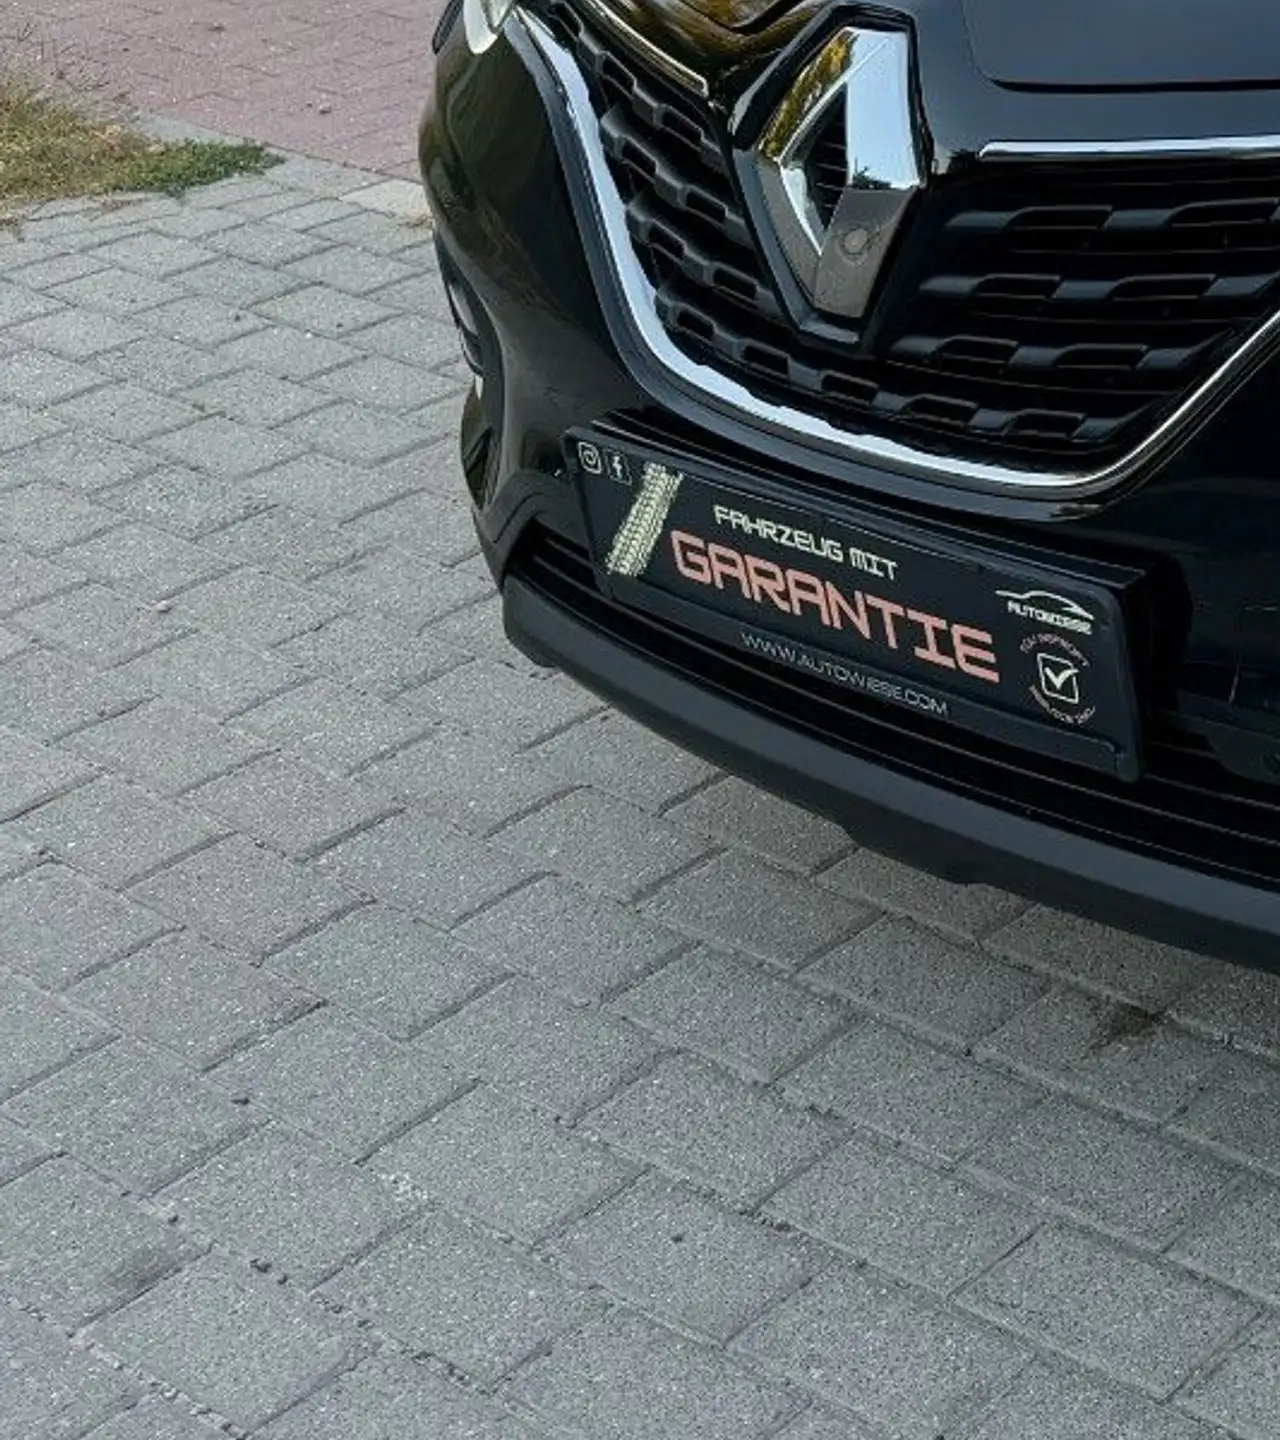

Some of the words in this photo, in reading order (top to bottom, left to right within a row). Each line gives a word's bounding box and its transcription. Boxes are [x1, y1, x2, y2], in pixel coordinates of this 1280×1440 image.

[713, 504, 844, 563] FAHRZEUG
[849, 546, 899, 581] MIT
[671, 529, 1000, 684] GARANTIE
